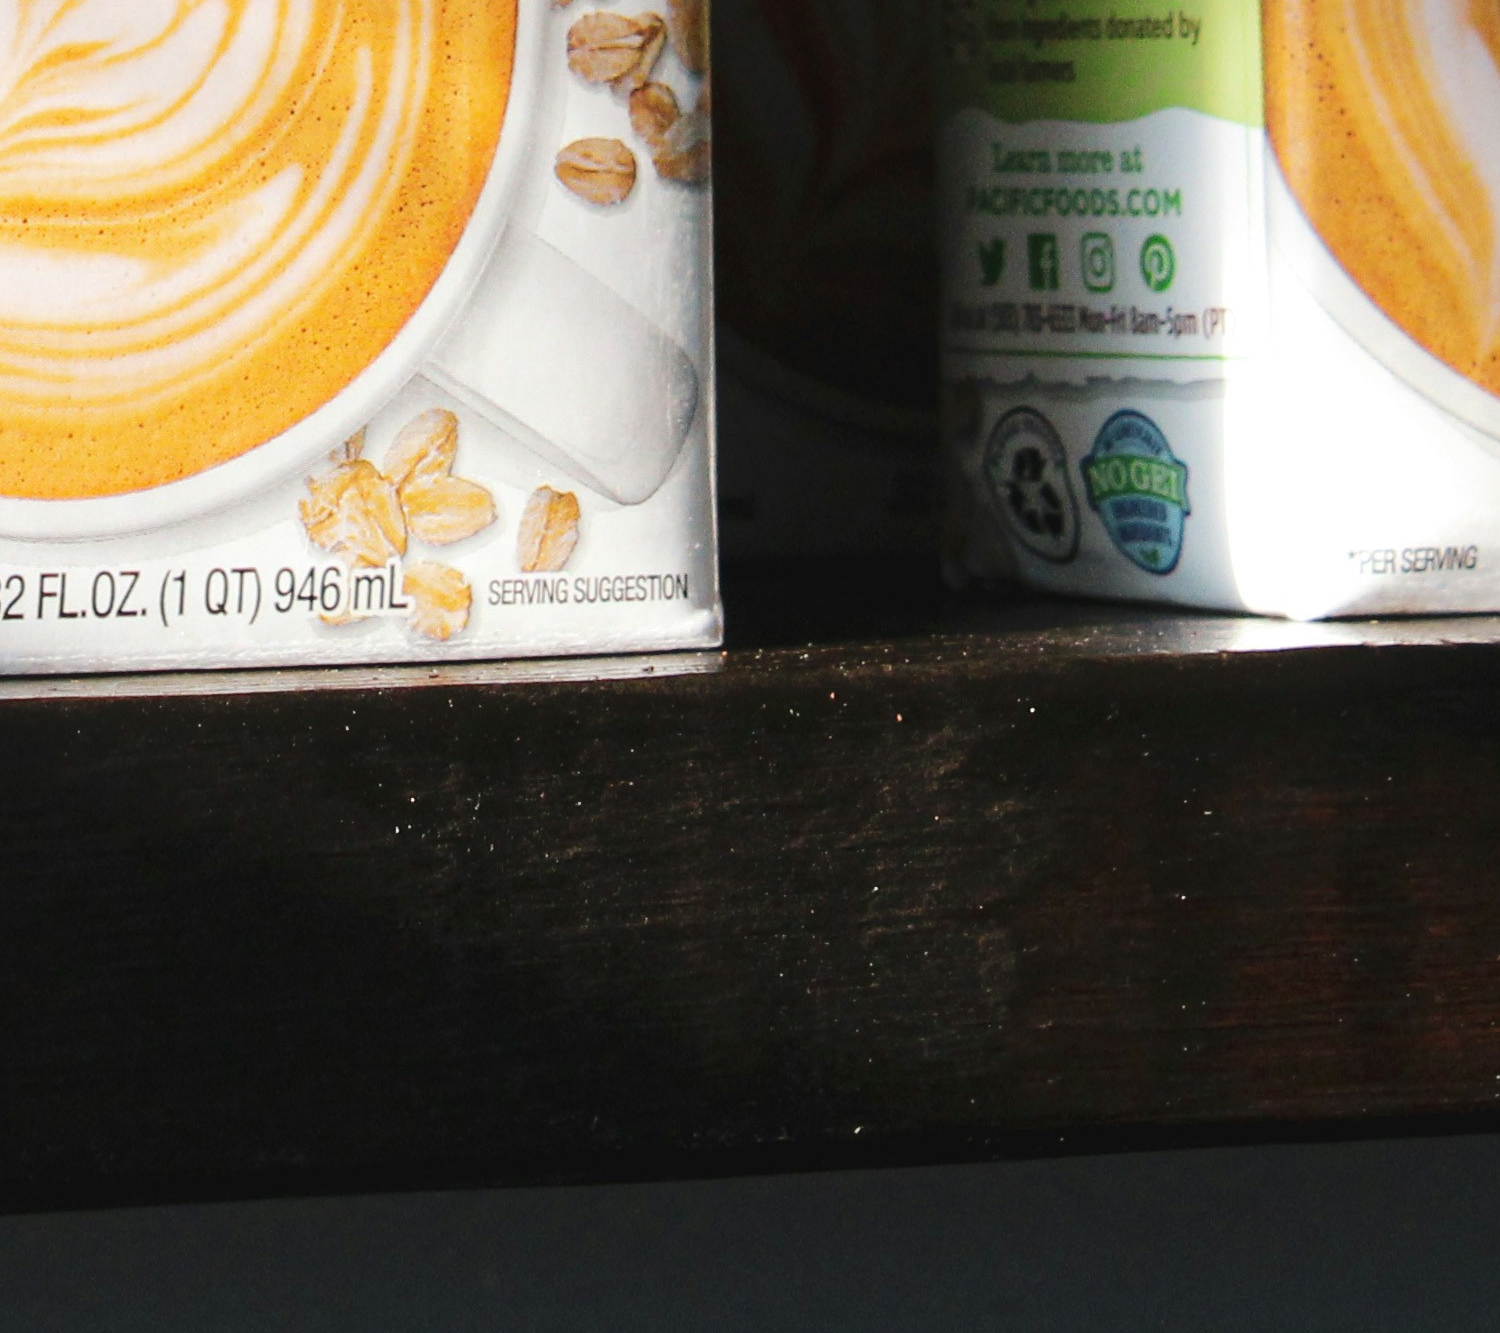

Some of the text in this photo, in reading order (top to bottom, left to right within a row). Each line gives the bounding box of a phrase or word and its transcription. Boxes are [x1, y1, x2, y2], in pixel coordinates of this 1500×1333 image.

[1400, 546, 1477, 573] SERVING
[36, 572, 149, 621] FL.OZ.
[158, 571, 188, 627] (1
[204, 569, 262, 623] QT)
[274, 565, 340, 614] 946
[353, 567, 408, 612] mL
[488, 571, 689, 607] SERVING SUGGESTION
